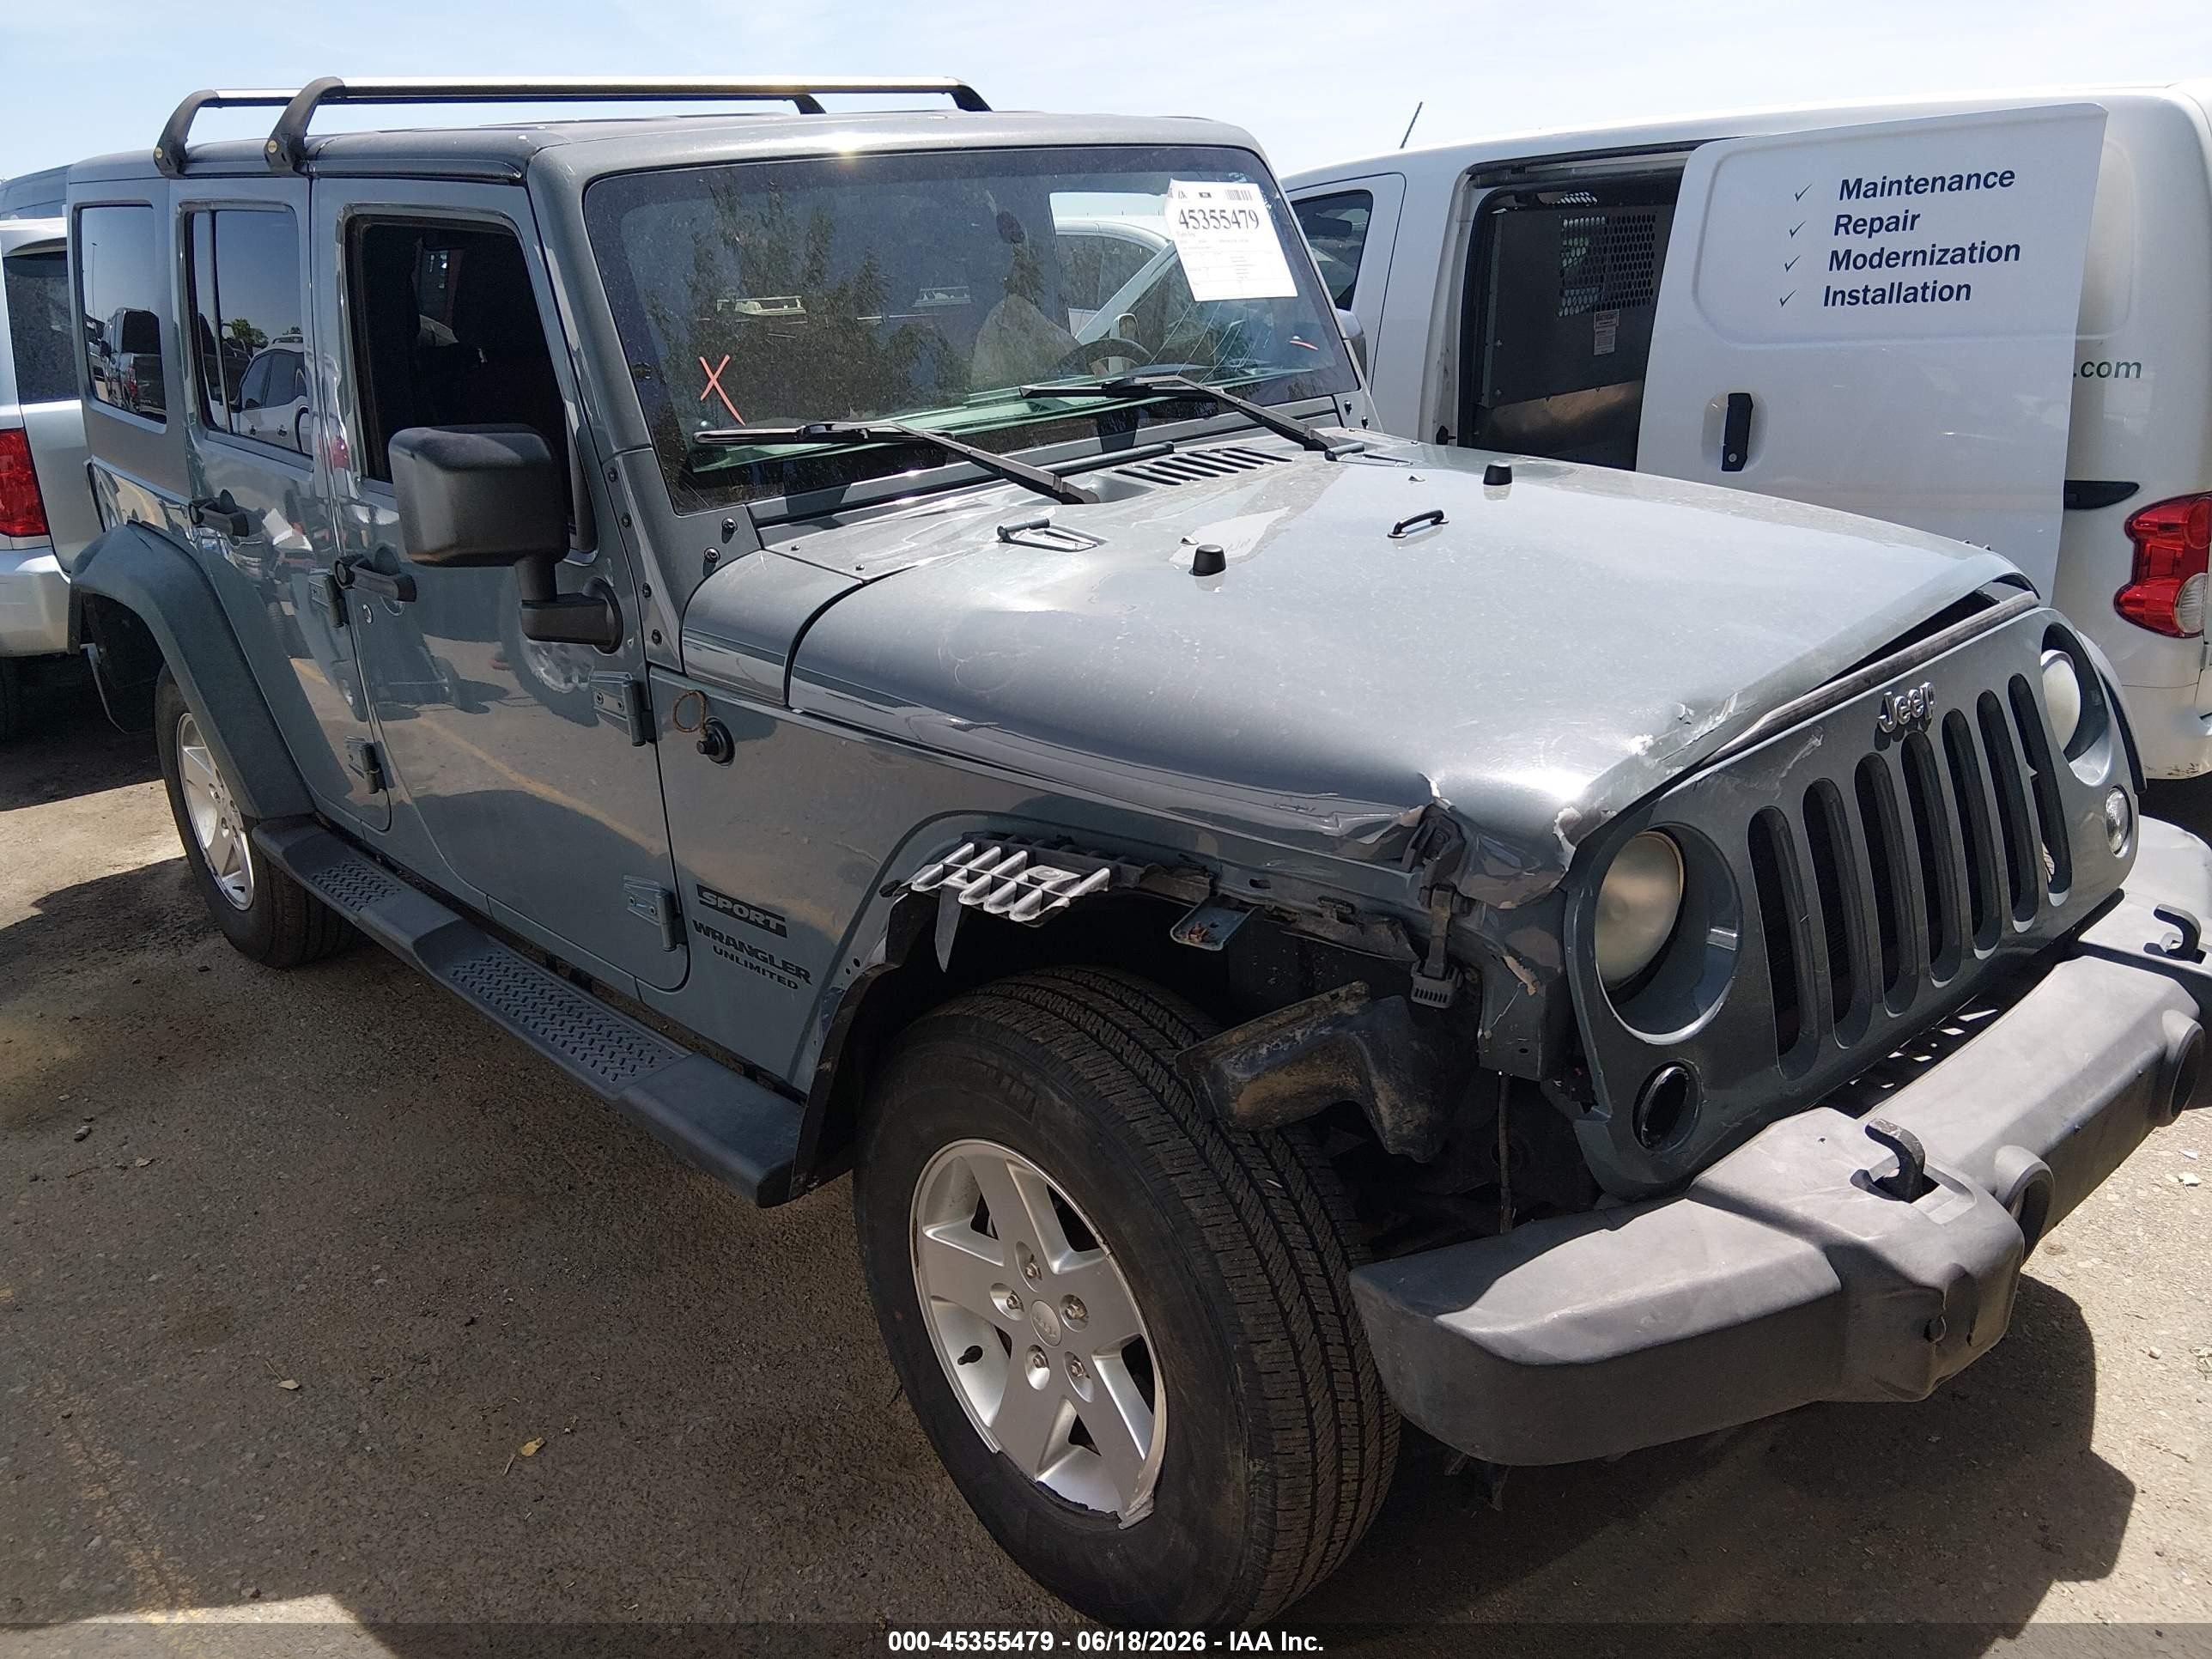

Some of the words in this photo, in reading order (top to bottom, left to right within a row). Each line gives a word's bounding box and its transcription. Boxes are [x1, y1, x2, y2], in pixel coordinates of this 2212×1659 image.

[1838, 169, 2016, 201] Maintenance
[1178, 209, 1260, 230] 45355479
[1833, 210, 1921, 239] Repair
[1828, 240, 2021, 272] Modernization
[1822, 280, 1972, 307] Installation
[2073, 361, 2142, 379] .com
[1875, 682, 1936, 733] Jeep
[702, 890, 786, 931] SPORT
[692, 919, 812, 986] WRANGLER
[713, 945, 799, 990] UNLIMITED
